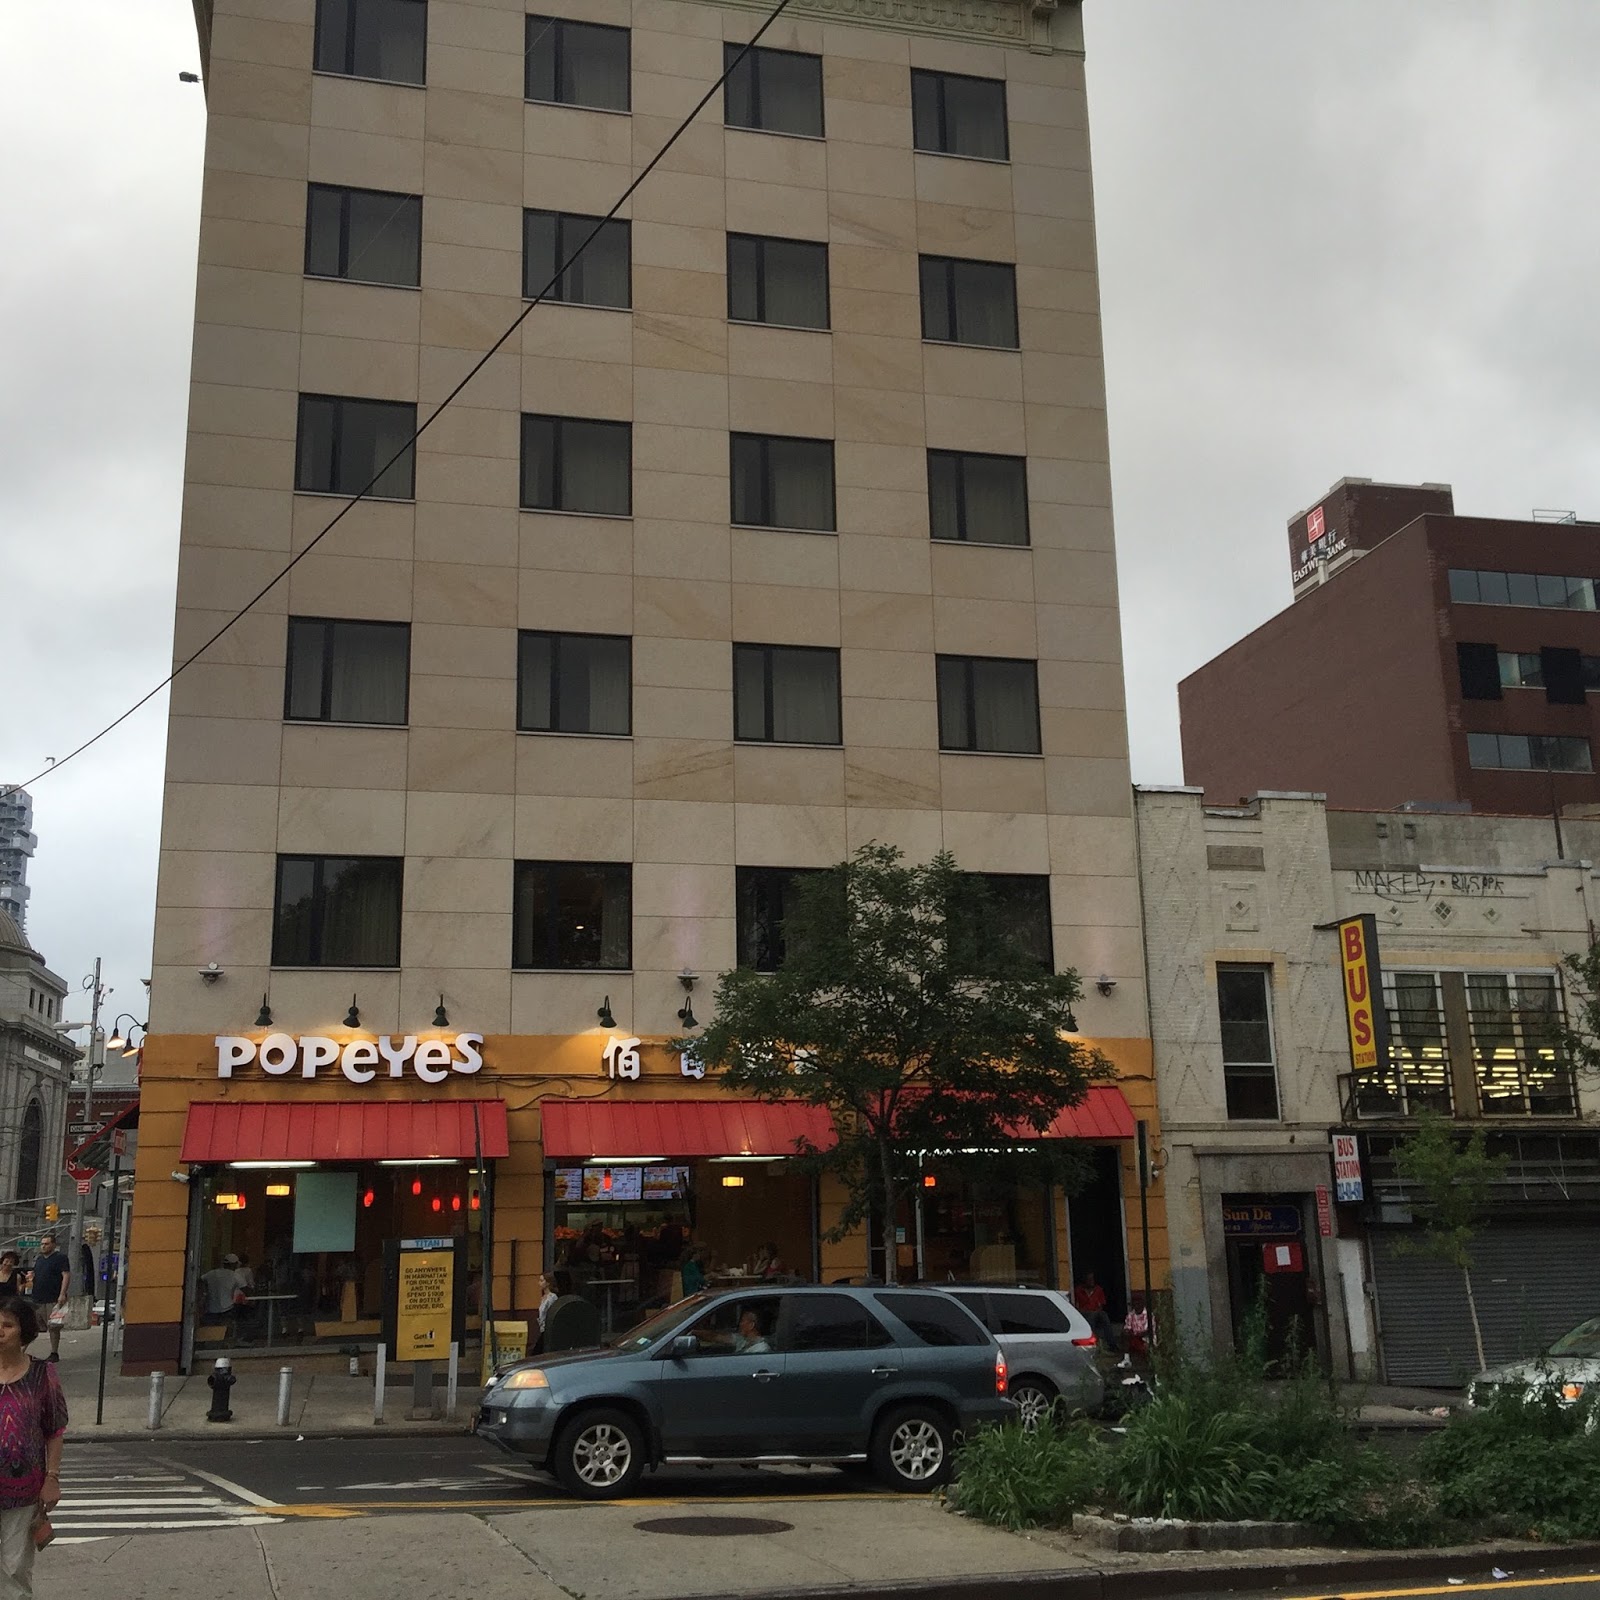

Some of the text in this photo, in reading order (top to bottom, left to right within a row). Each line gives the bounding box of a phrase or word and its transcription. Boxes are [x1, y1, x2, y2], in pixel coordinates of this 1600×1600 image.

[1344, 925, 1372, 1047] BUS
[1355, 1051, 1376, 1065] STATION
[71, 1124, 84, 1132] ONE
[1337, 1137, 1354, 1157] BUS
[1335, 1160, 1361, 1179] STATION
[1223, 1207, 1272, 1221] Sun Da
[415, 1239, 440, 1247] TITAN
